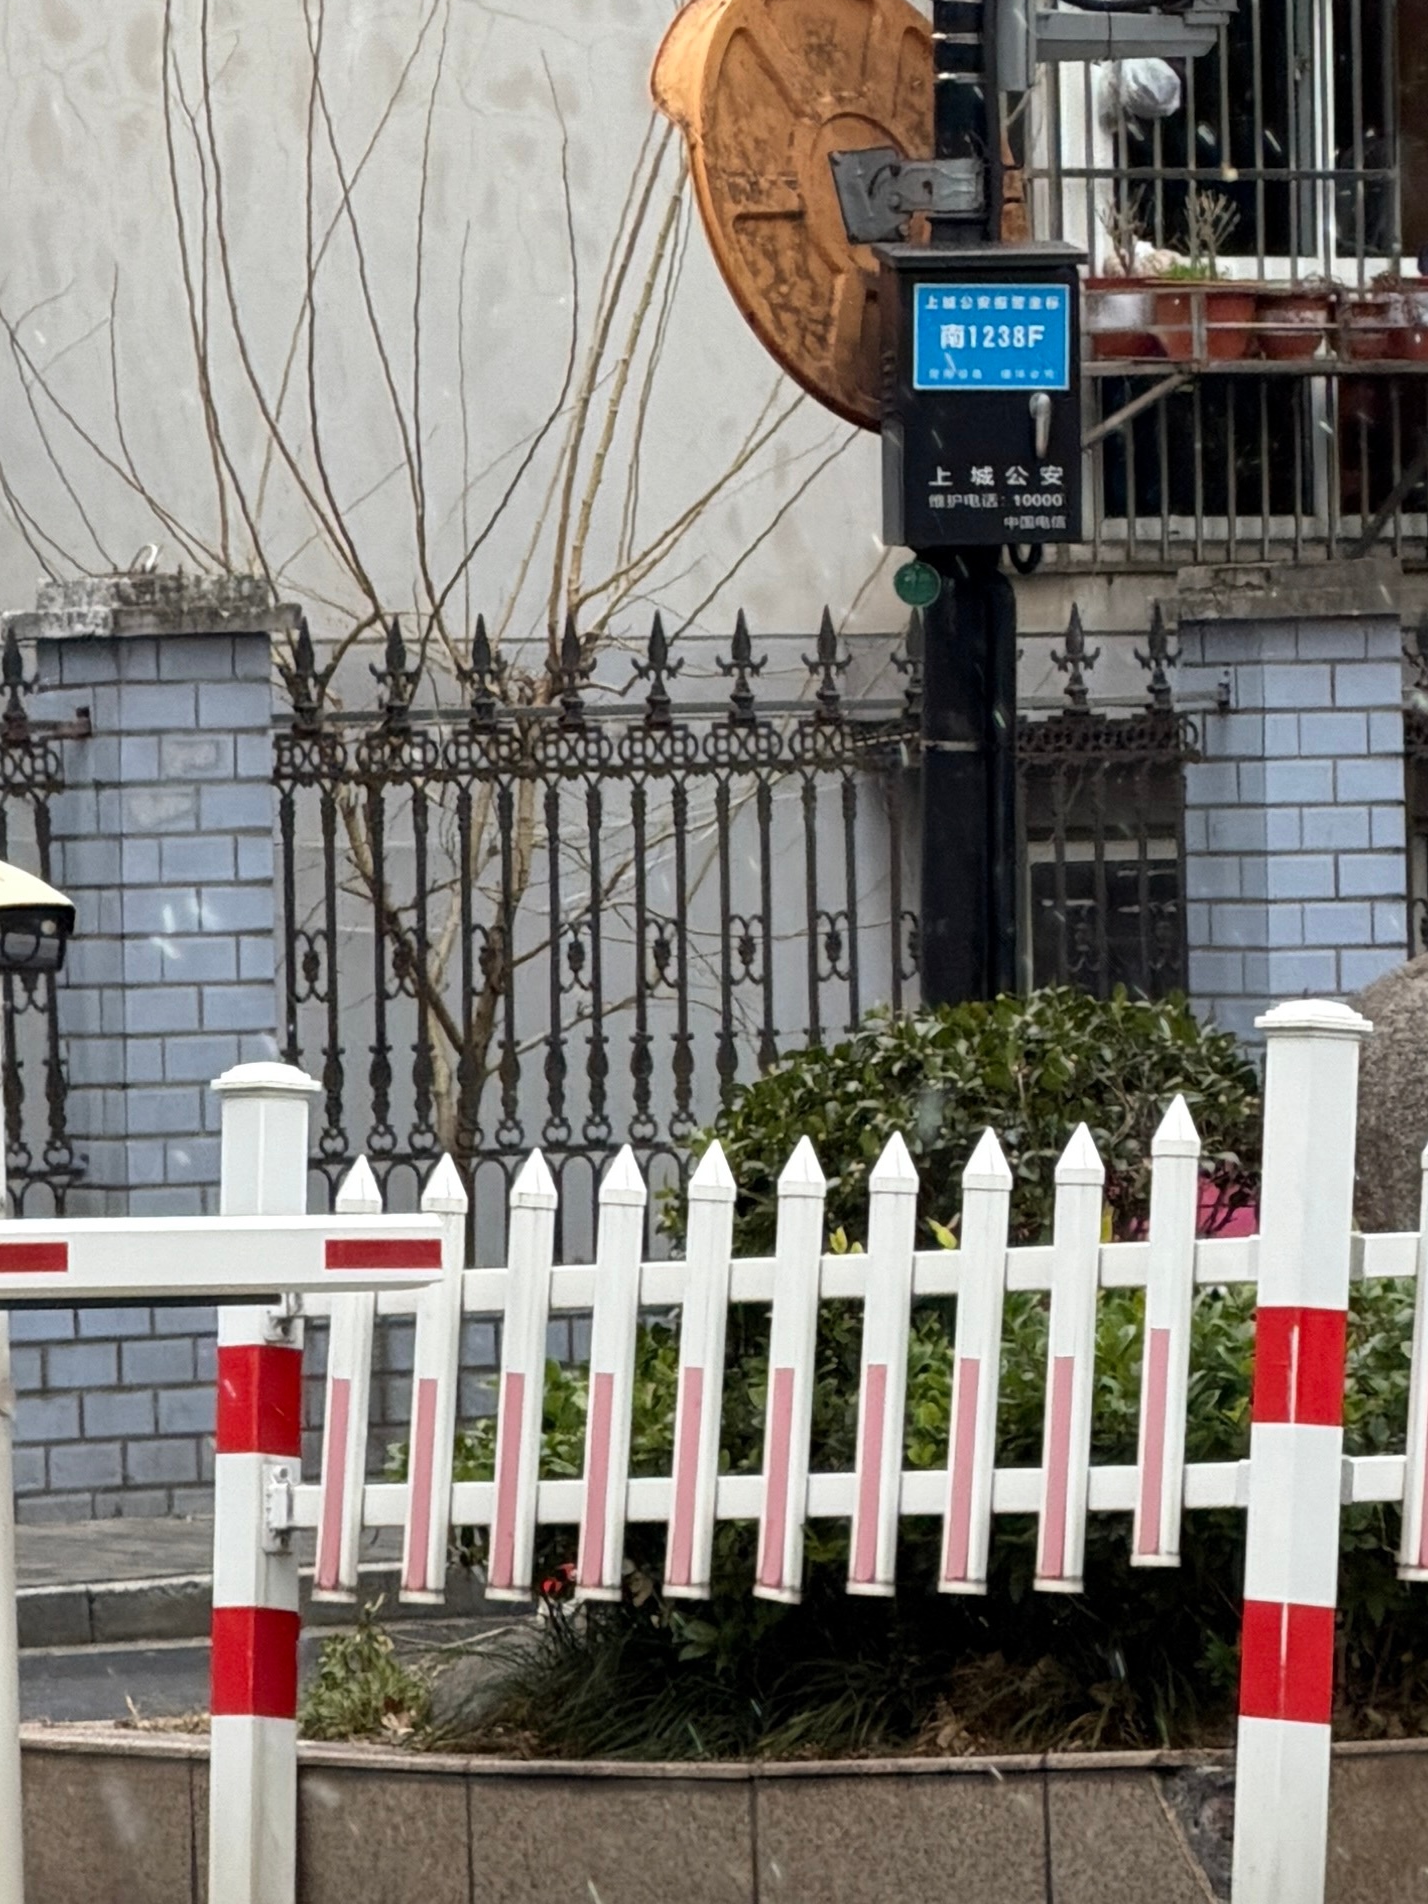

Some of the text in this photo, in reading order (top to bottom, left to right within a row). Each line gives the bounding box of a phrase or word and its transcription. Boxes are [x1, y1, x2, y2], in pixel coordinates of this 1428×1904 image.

[940, 324, 1046, 349] 南1238F
[928, 464, 1064, 486] 上城公安
[1003, 515, 1067, 530] 中国电信
